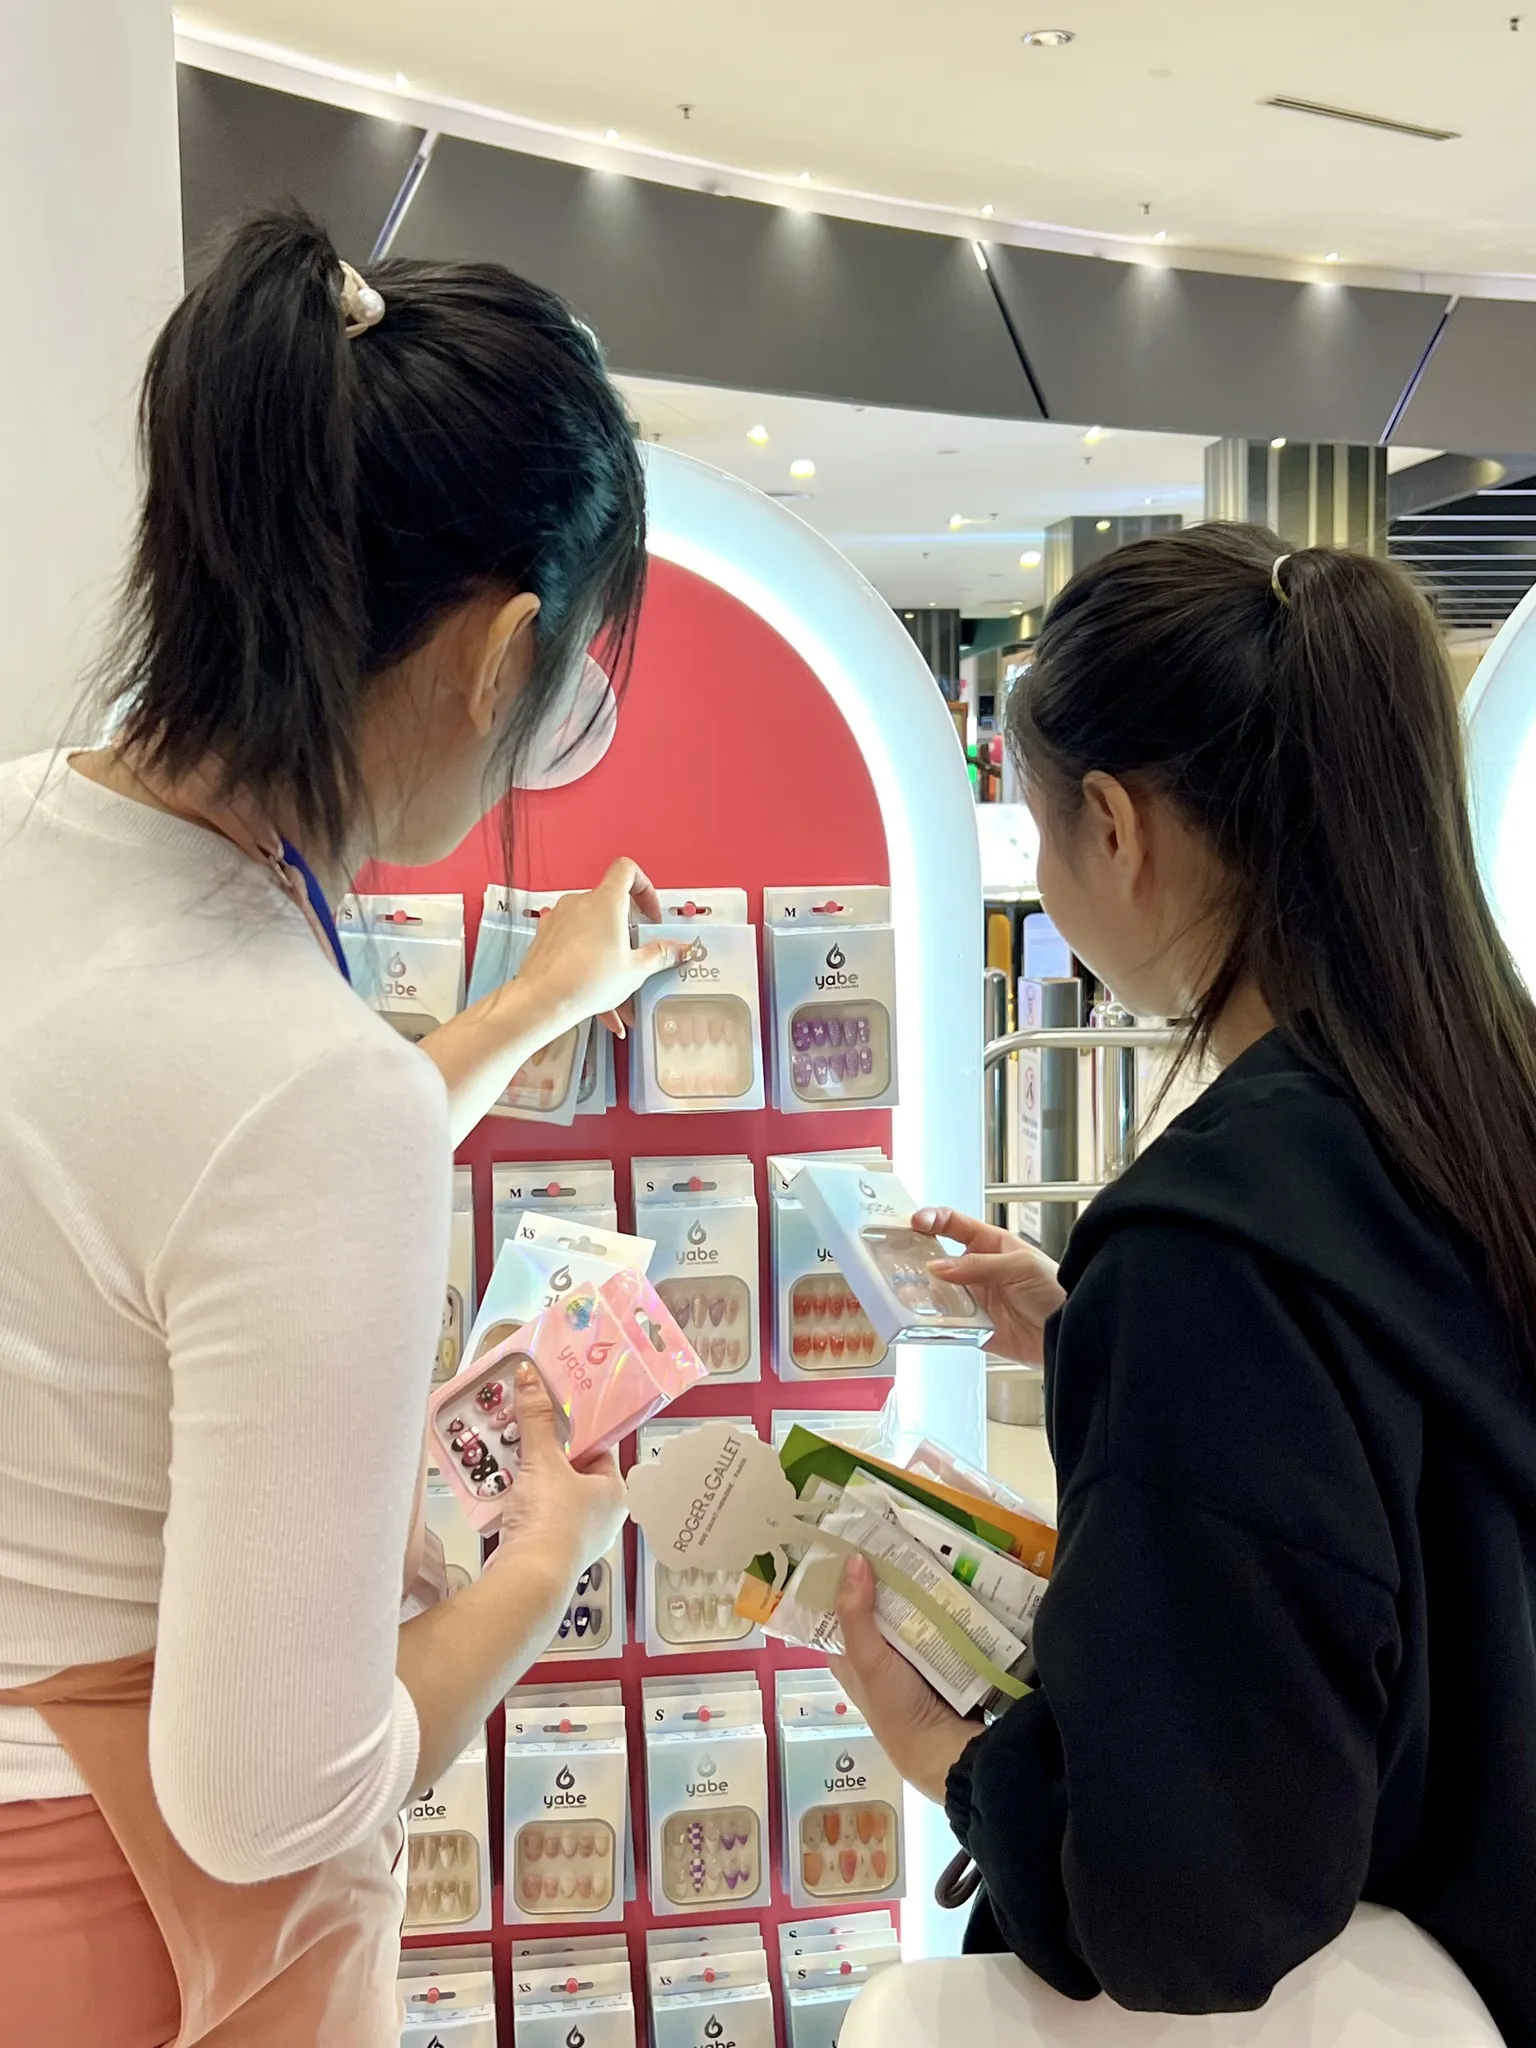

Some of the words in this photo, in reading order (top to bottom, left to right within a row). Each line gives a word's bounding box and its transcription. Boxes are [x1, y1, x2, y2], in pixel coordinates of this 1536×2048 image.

[344, 909, 353, 920] S
[784, 907, 797, 917] M
[678, 965, 720, 982] yabe
[815, 971, 859, 990] yabe
[646, 1181, 655, 1192] S
[781, 1180, 789, 1189] S
[509, 1188, 522, 1198] M
[519, 1226, 536, 1240] XS
[676, 1247, 719, 1265] yabe
[704, 1436, 741, 1491] GALLET
[703, 1491, 716, 1502] &
[673, 1499, 709, 1553] ROGER
[655, 1708, 665, 1721] S
[799, 1706, 809, 1716] L
[515, 1723, 524, 1733] S
[686, 1779, 729, 1798] yabe
[825, 1774, 867, 1792] yabe
[543, 1791, 587, 1809] yabe
[797, 1969, 806, 1980] S
[659, 1976, 672, 1986] XS
[518, 1983, 531, 1993] XS
